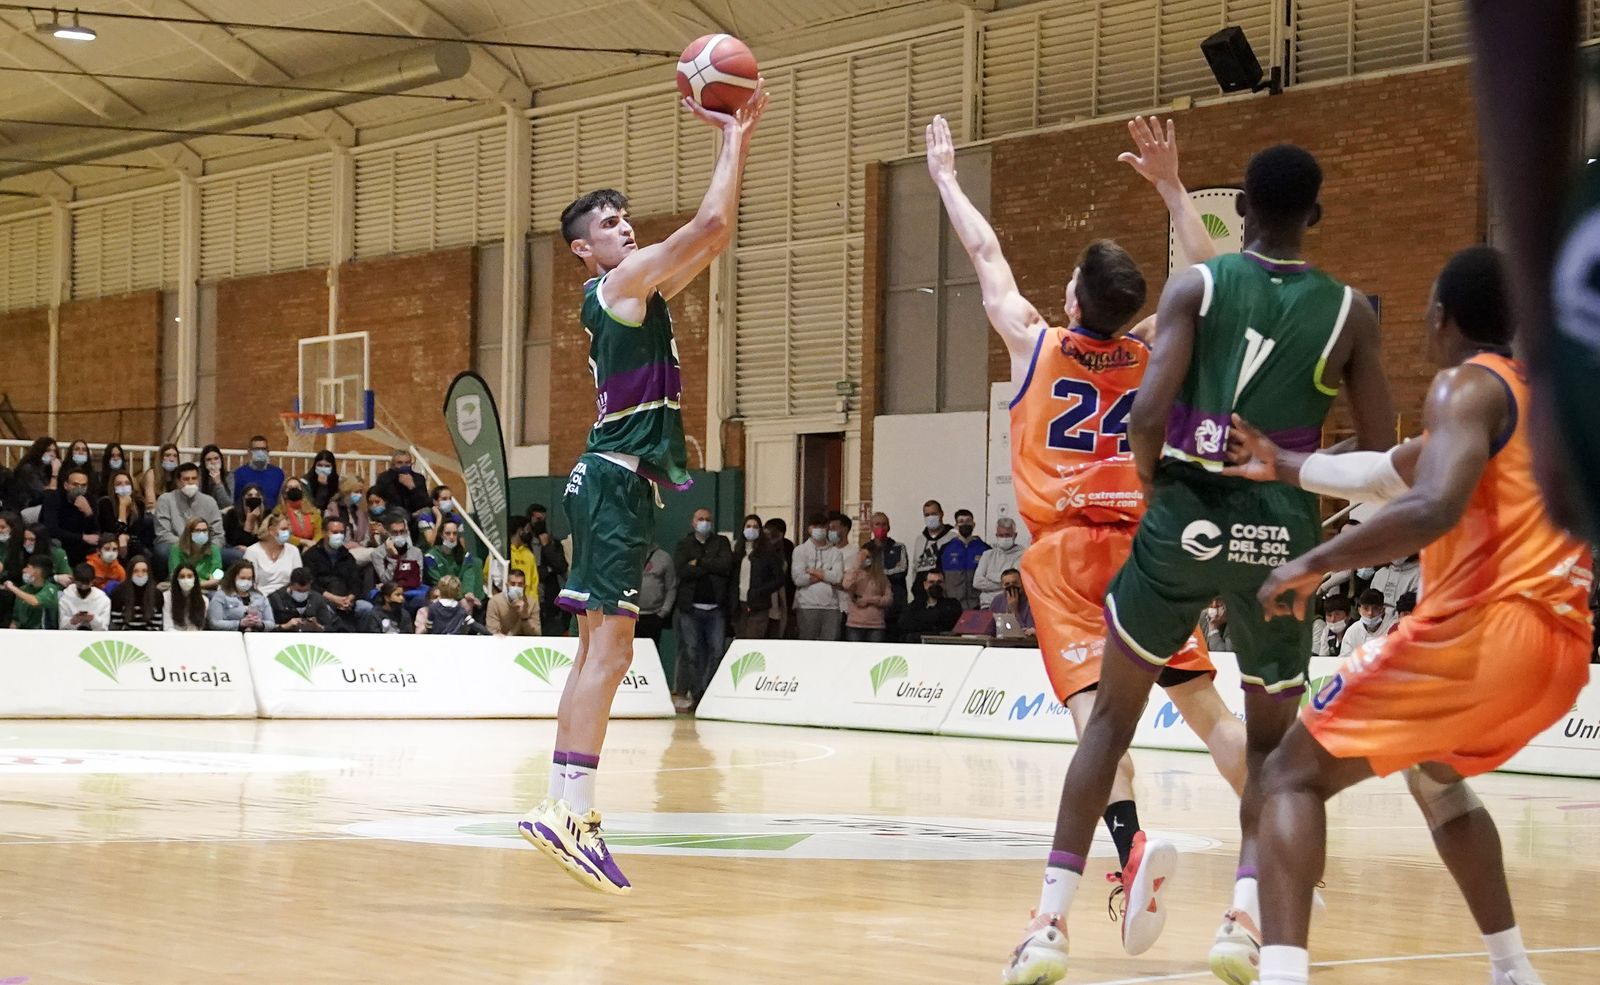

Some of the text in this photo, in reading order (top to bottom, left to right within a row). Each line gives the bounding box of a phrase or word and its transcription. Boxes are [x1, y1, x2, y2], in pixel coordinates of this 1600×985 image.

[1046, 376, 1139, 454] 24
[1087, 490, 1144, 500] extremadu
[1230, 523, 1291, 541] COSTA
[1229, 540, 1290, 555] DEL SOL
[149, 665, 232, 687] Unicaja
[341, 667, 418, 688] Unicaja
[754, 675, 800, 696] Unicaja
[896, 681, 944, 703] Unicaja
